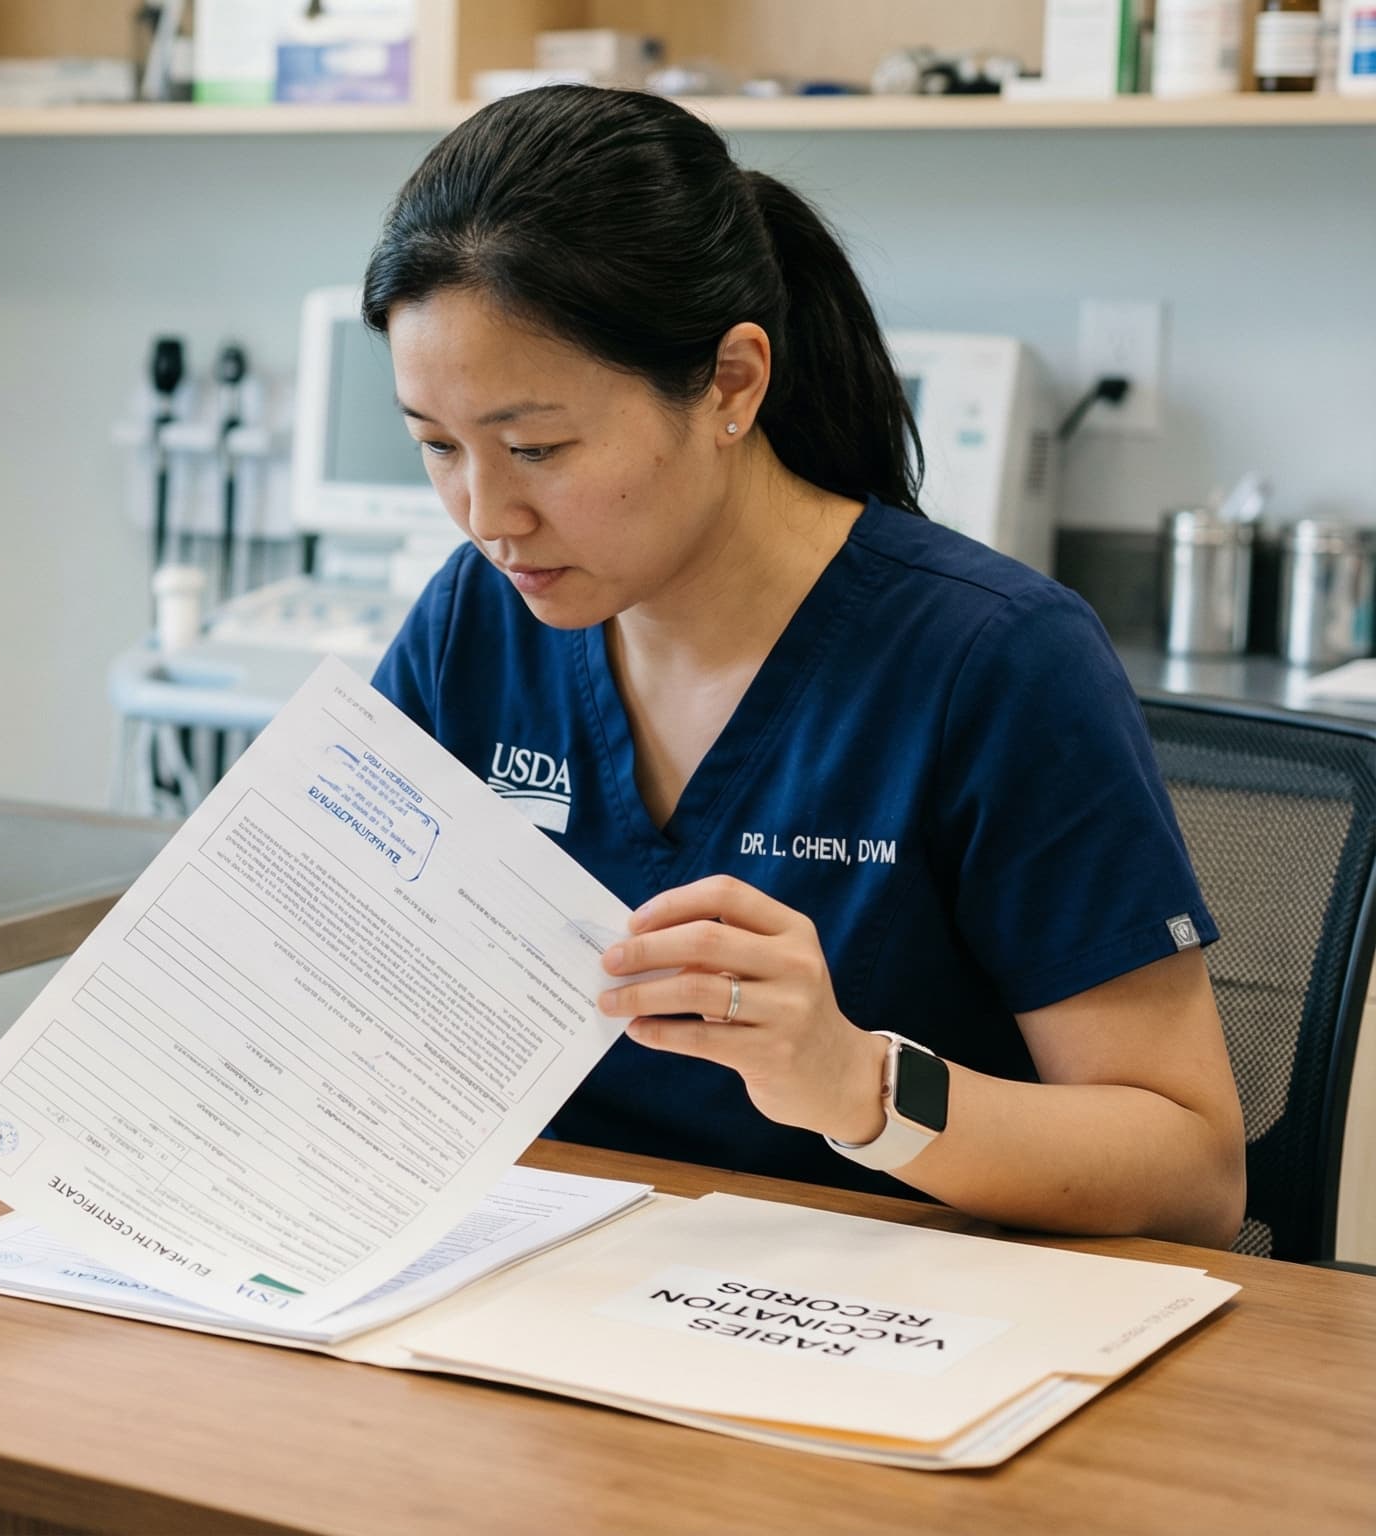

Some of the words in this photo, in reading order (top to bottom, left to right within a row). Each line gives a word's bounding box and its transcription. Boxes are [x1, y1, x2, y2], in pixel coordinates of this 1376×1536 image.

[491, 742, 572, 794] USDA
[740, 832, 767, 856] DR.
[772, 834, 786, 857] L.
[792, 835, 851, 866] CHEN,
[858, 839, 896, 864] DVM
[47, 1175, 134, 1238] CERTIFICATE
[132, 1231, 190, 1268] HEALTH
[189, 1261, 212, 1279] EU
[650, 1289, 944, 1350] VACCINATION
[717, 1282, 932, 1328] RECORDS
[687, 1317, 856, 1357] RABIES
